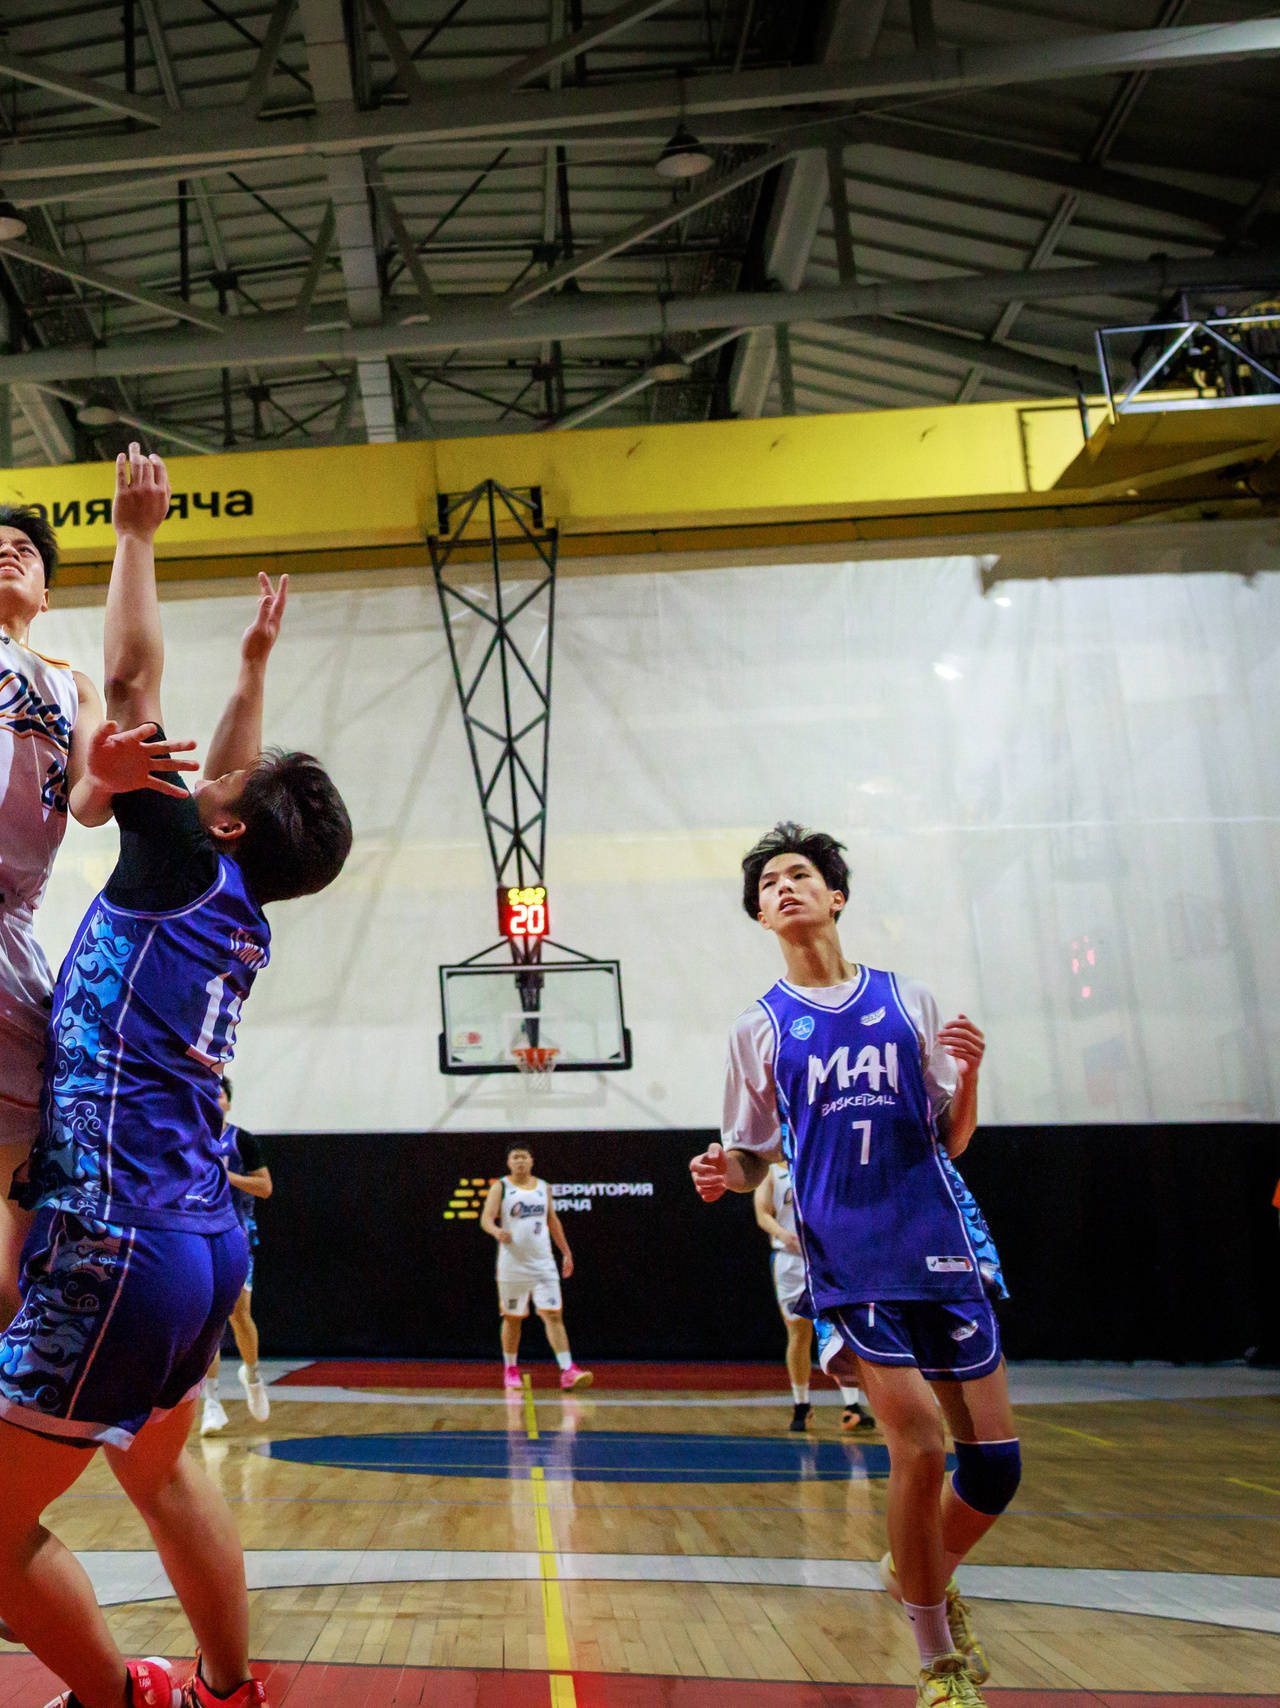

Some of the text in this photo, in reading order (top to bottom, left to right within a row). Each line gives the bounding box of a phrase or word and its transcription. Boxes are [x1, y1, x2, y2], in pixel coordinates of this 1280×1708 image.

[510, 904, 545, 934] 20
[807, 1042, 899, 1106] MAI
[821, 1093, 896, 1117] BASKETBALL
[852, 1119, 872, 1165] 7
[551, 1182, 654, 1197] ЕРРИТОРИЯ
